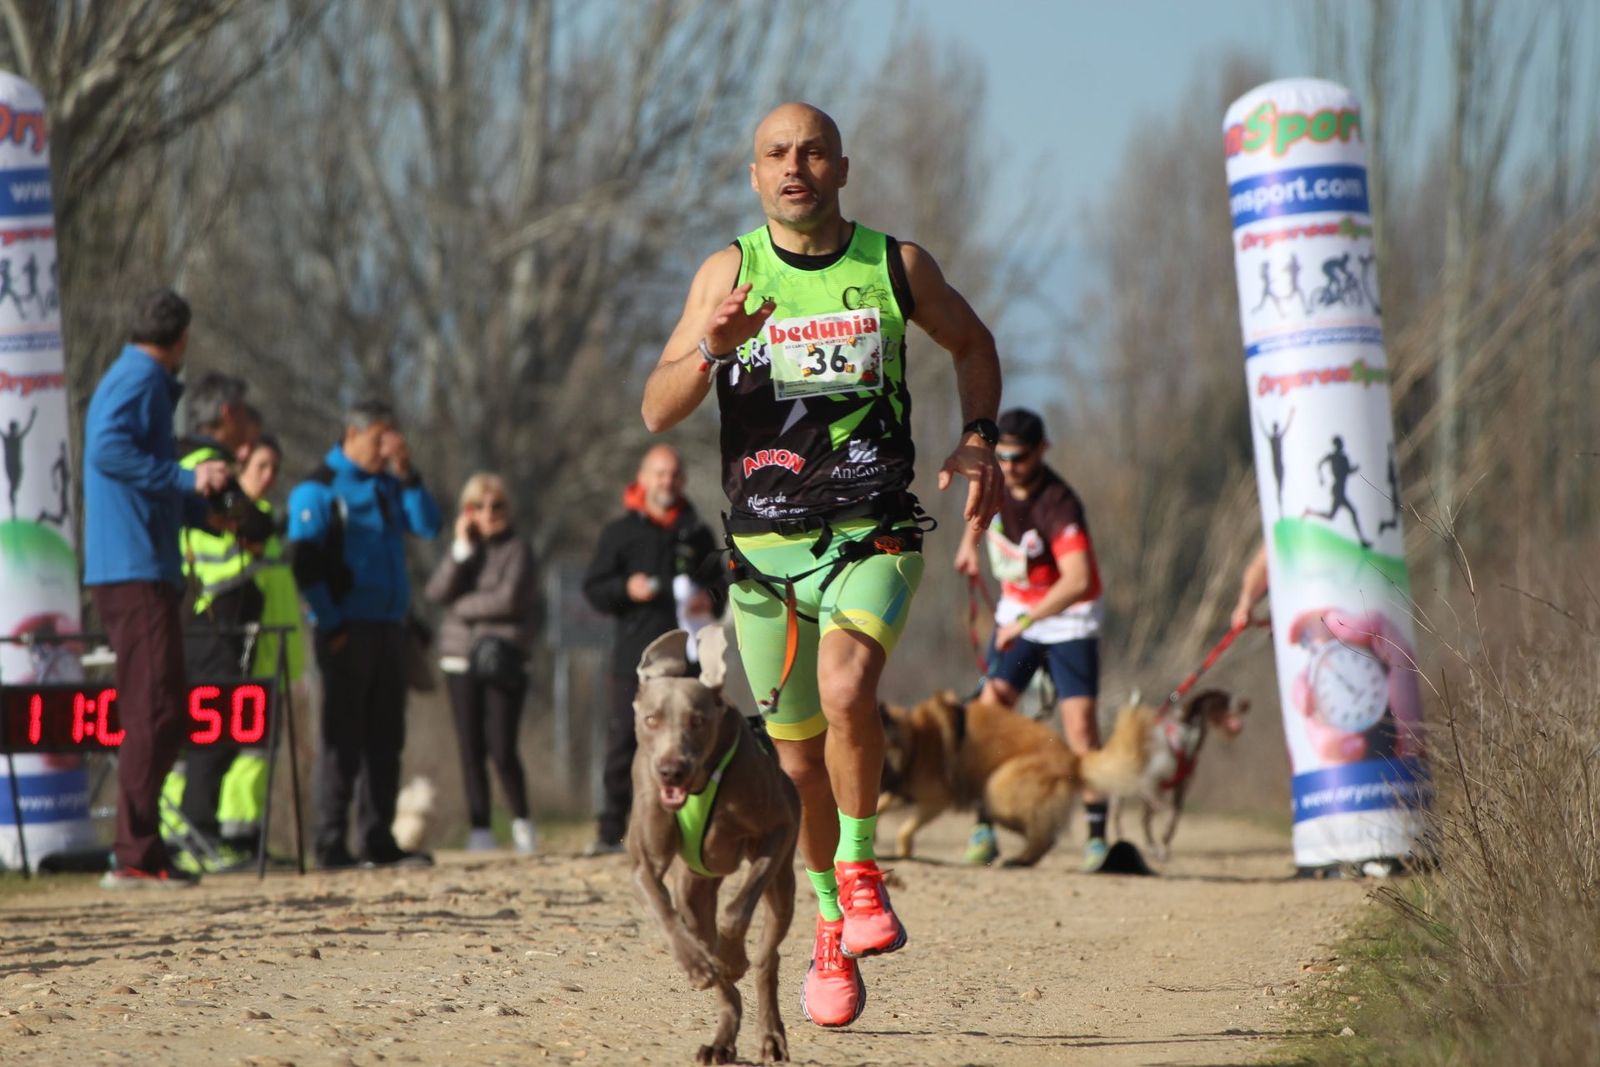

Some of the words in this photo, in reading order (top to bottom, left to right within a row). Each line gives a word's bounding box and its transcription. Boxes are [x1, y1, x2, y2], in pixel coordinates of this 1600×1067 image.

[769, 315, 878, 345] bedunia
[807, 345, 848, 375] 36
[742, 449, 806, 478] ARION
[188, 684, 266, 744] 50
